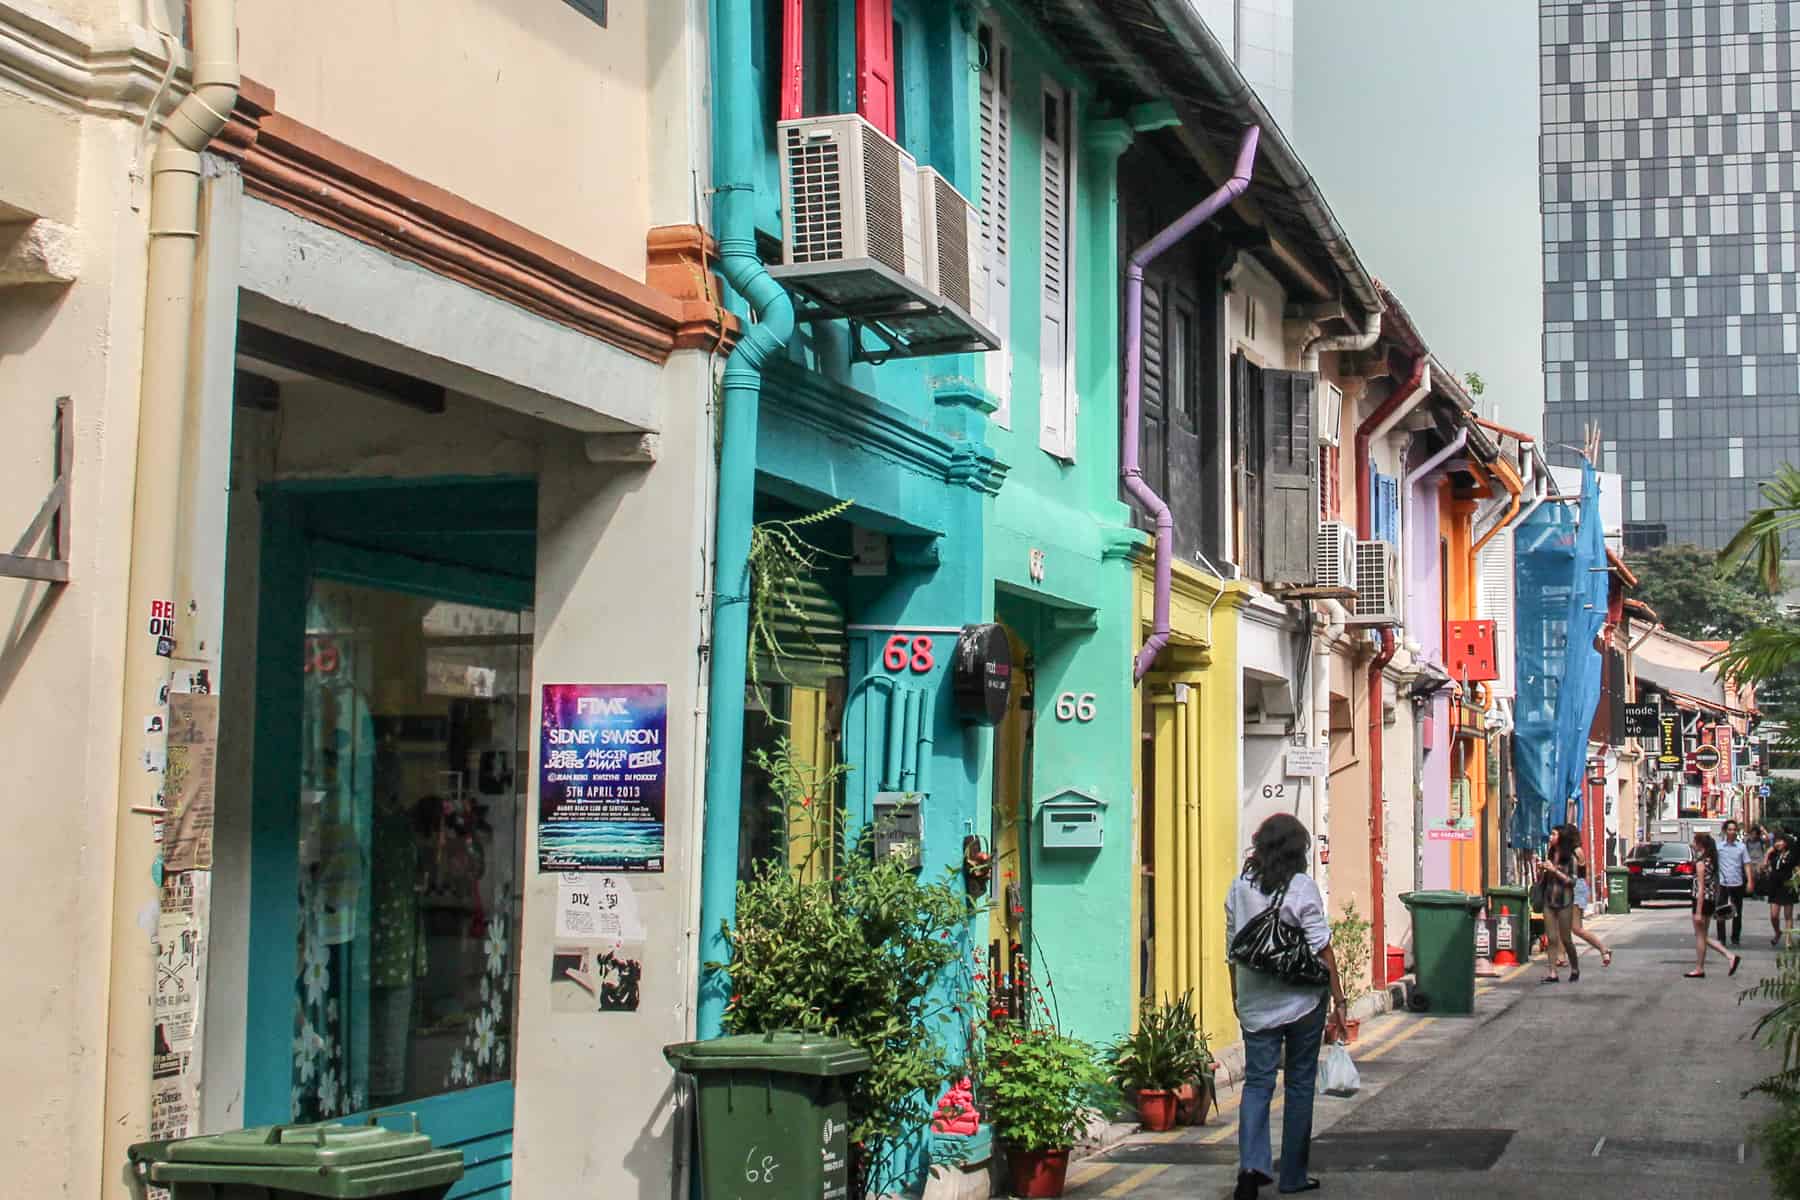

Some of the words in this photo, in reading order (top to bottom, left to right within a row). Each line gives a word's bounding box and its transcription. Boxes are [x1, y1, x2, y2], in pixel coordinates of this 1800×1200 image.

[151, 600, 175, 618] RE
[149, 619, 174, 636] ON
[883, 634, 934, 672] 68
[1055, 692, 1098, 721] 66
[549, 729, 598, 744] SIDNEY
[601, 729, 659, 744] SAMSON
[628, 750, 662, 768] PERK
[566, 786, 583, 798] 5TH
[587, 786, 613, 798] APRIL
[617, 786, 640, 798] 2013
[1262, 784, 1285, 799] 62
[745, 1146, 782, 1182] 68
